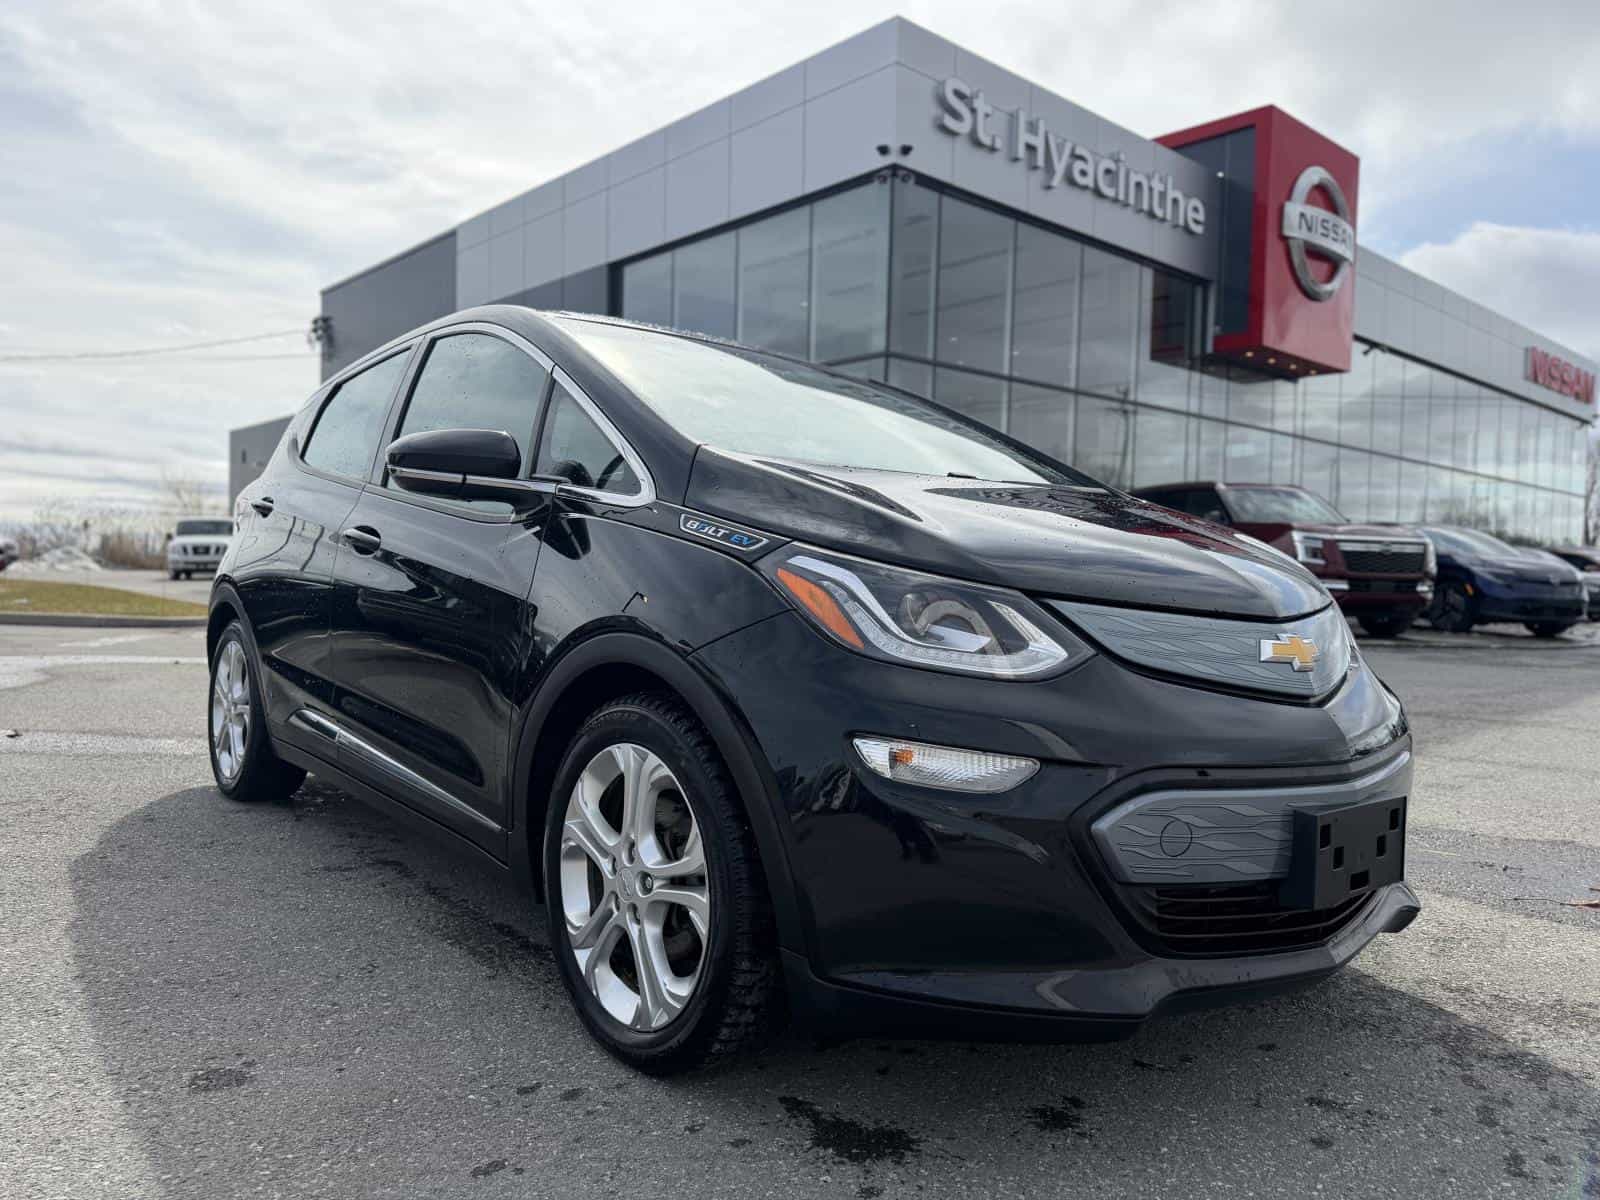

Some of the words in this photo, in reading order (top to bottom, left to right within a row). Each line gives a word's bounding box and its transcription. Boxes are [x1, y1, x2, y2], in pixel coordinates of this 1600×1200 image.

[942, 76, 1002, 149] St.
[1017, 109, 1205, 234] Hyacinthe
[1528, 346, 1594, 404] NISSAN
[685, 520, 729, 537] BOLT
[730, 533, 753, 546] EV
